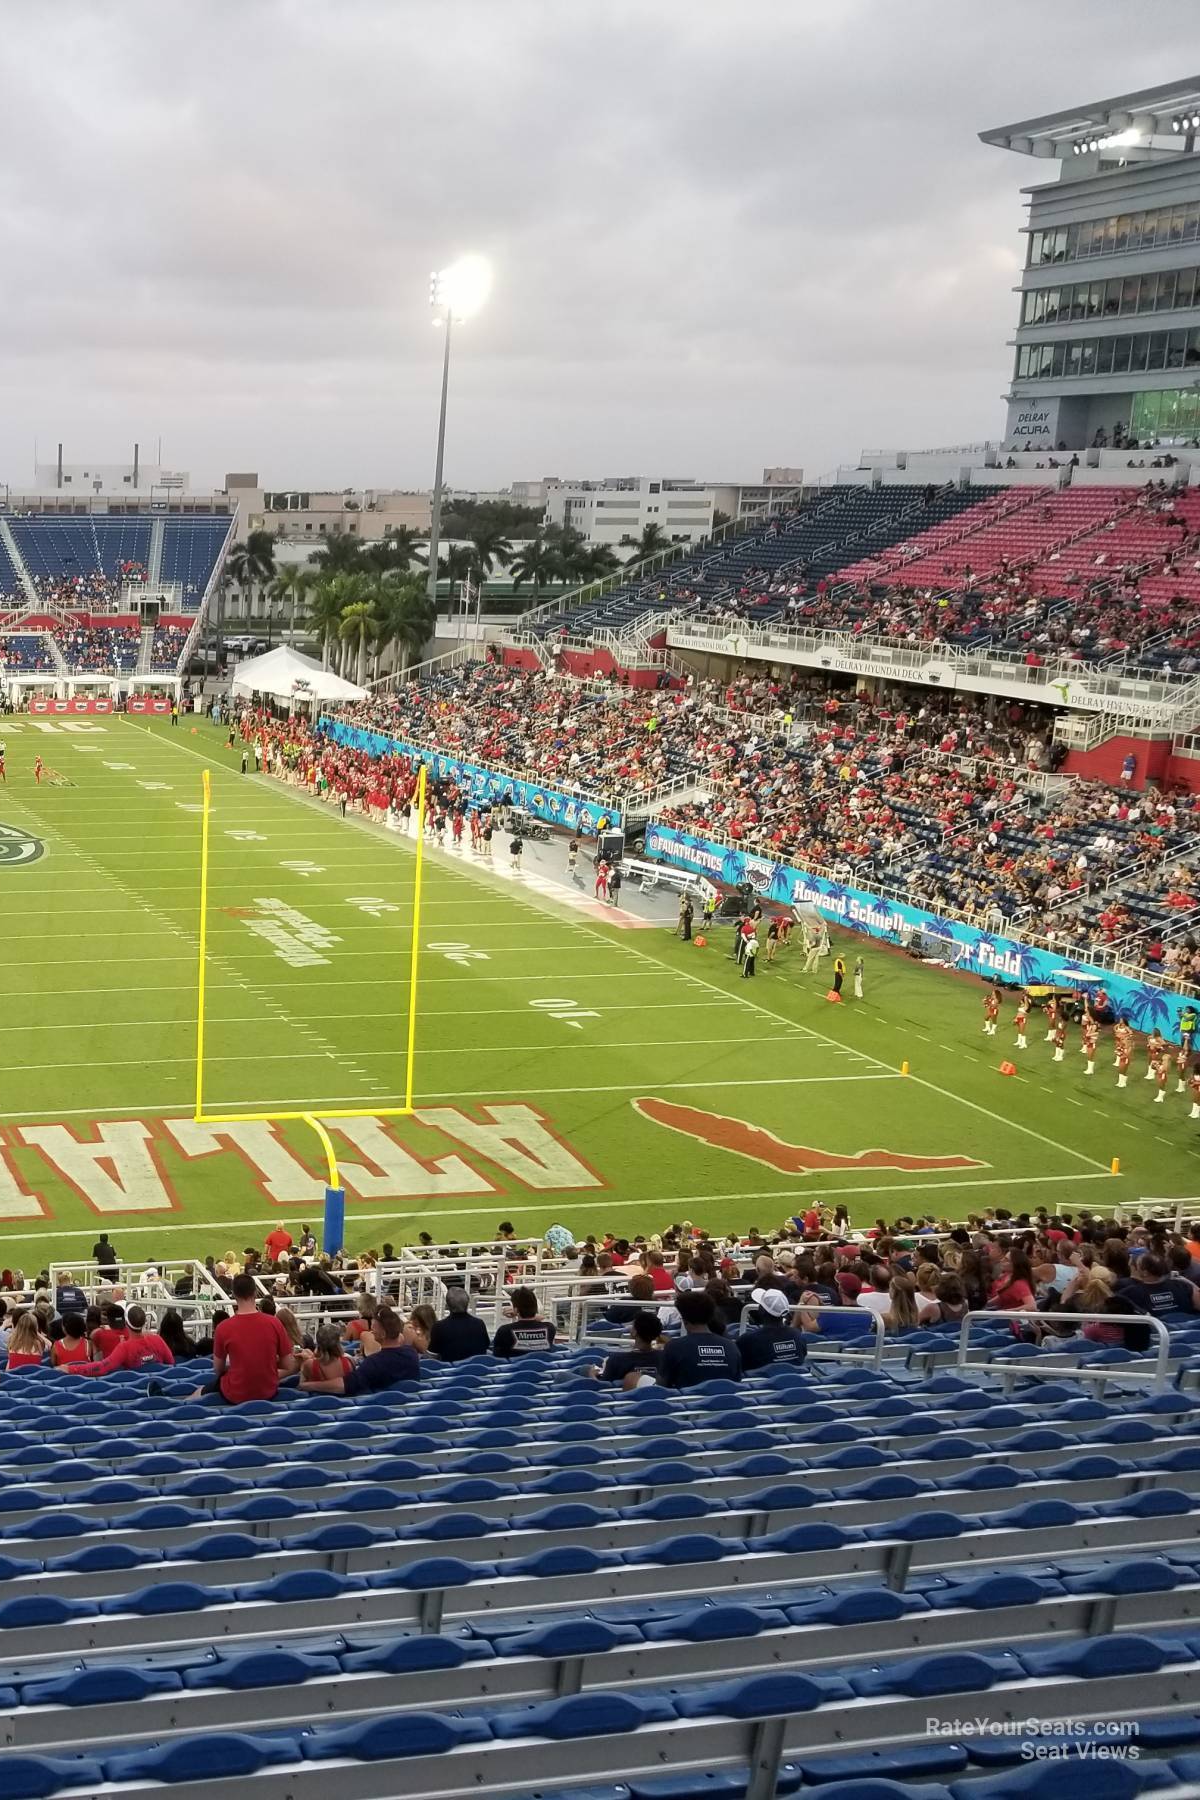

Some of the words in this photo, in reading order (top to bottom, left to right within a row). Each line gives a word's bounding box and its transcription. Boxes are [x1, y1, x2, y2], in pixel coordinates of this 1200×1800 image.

[1018, 412, 1050, 423] DELRAY
[1013, 425, 1050, 436] ACURA
[835, 659, 863, 672] DELRAY
[864, 663, 901, 677] HYUNDAI
[902, 668, 924, 681] DECK
[1071, 695, 1105, 708] DELRAY
[650, 834, 723, 872] @FAUATHLETICS
[792, 879, 847, 915] Howard
[977, 940, 1023, 976] Field
[426, 942, 492, 961] 20
[528, 998, 603, 1019] 10
[700, 1347, 723, 1355] Hilton
